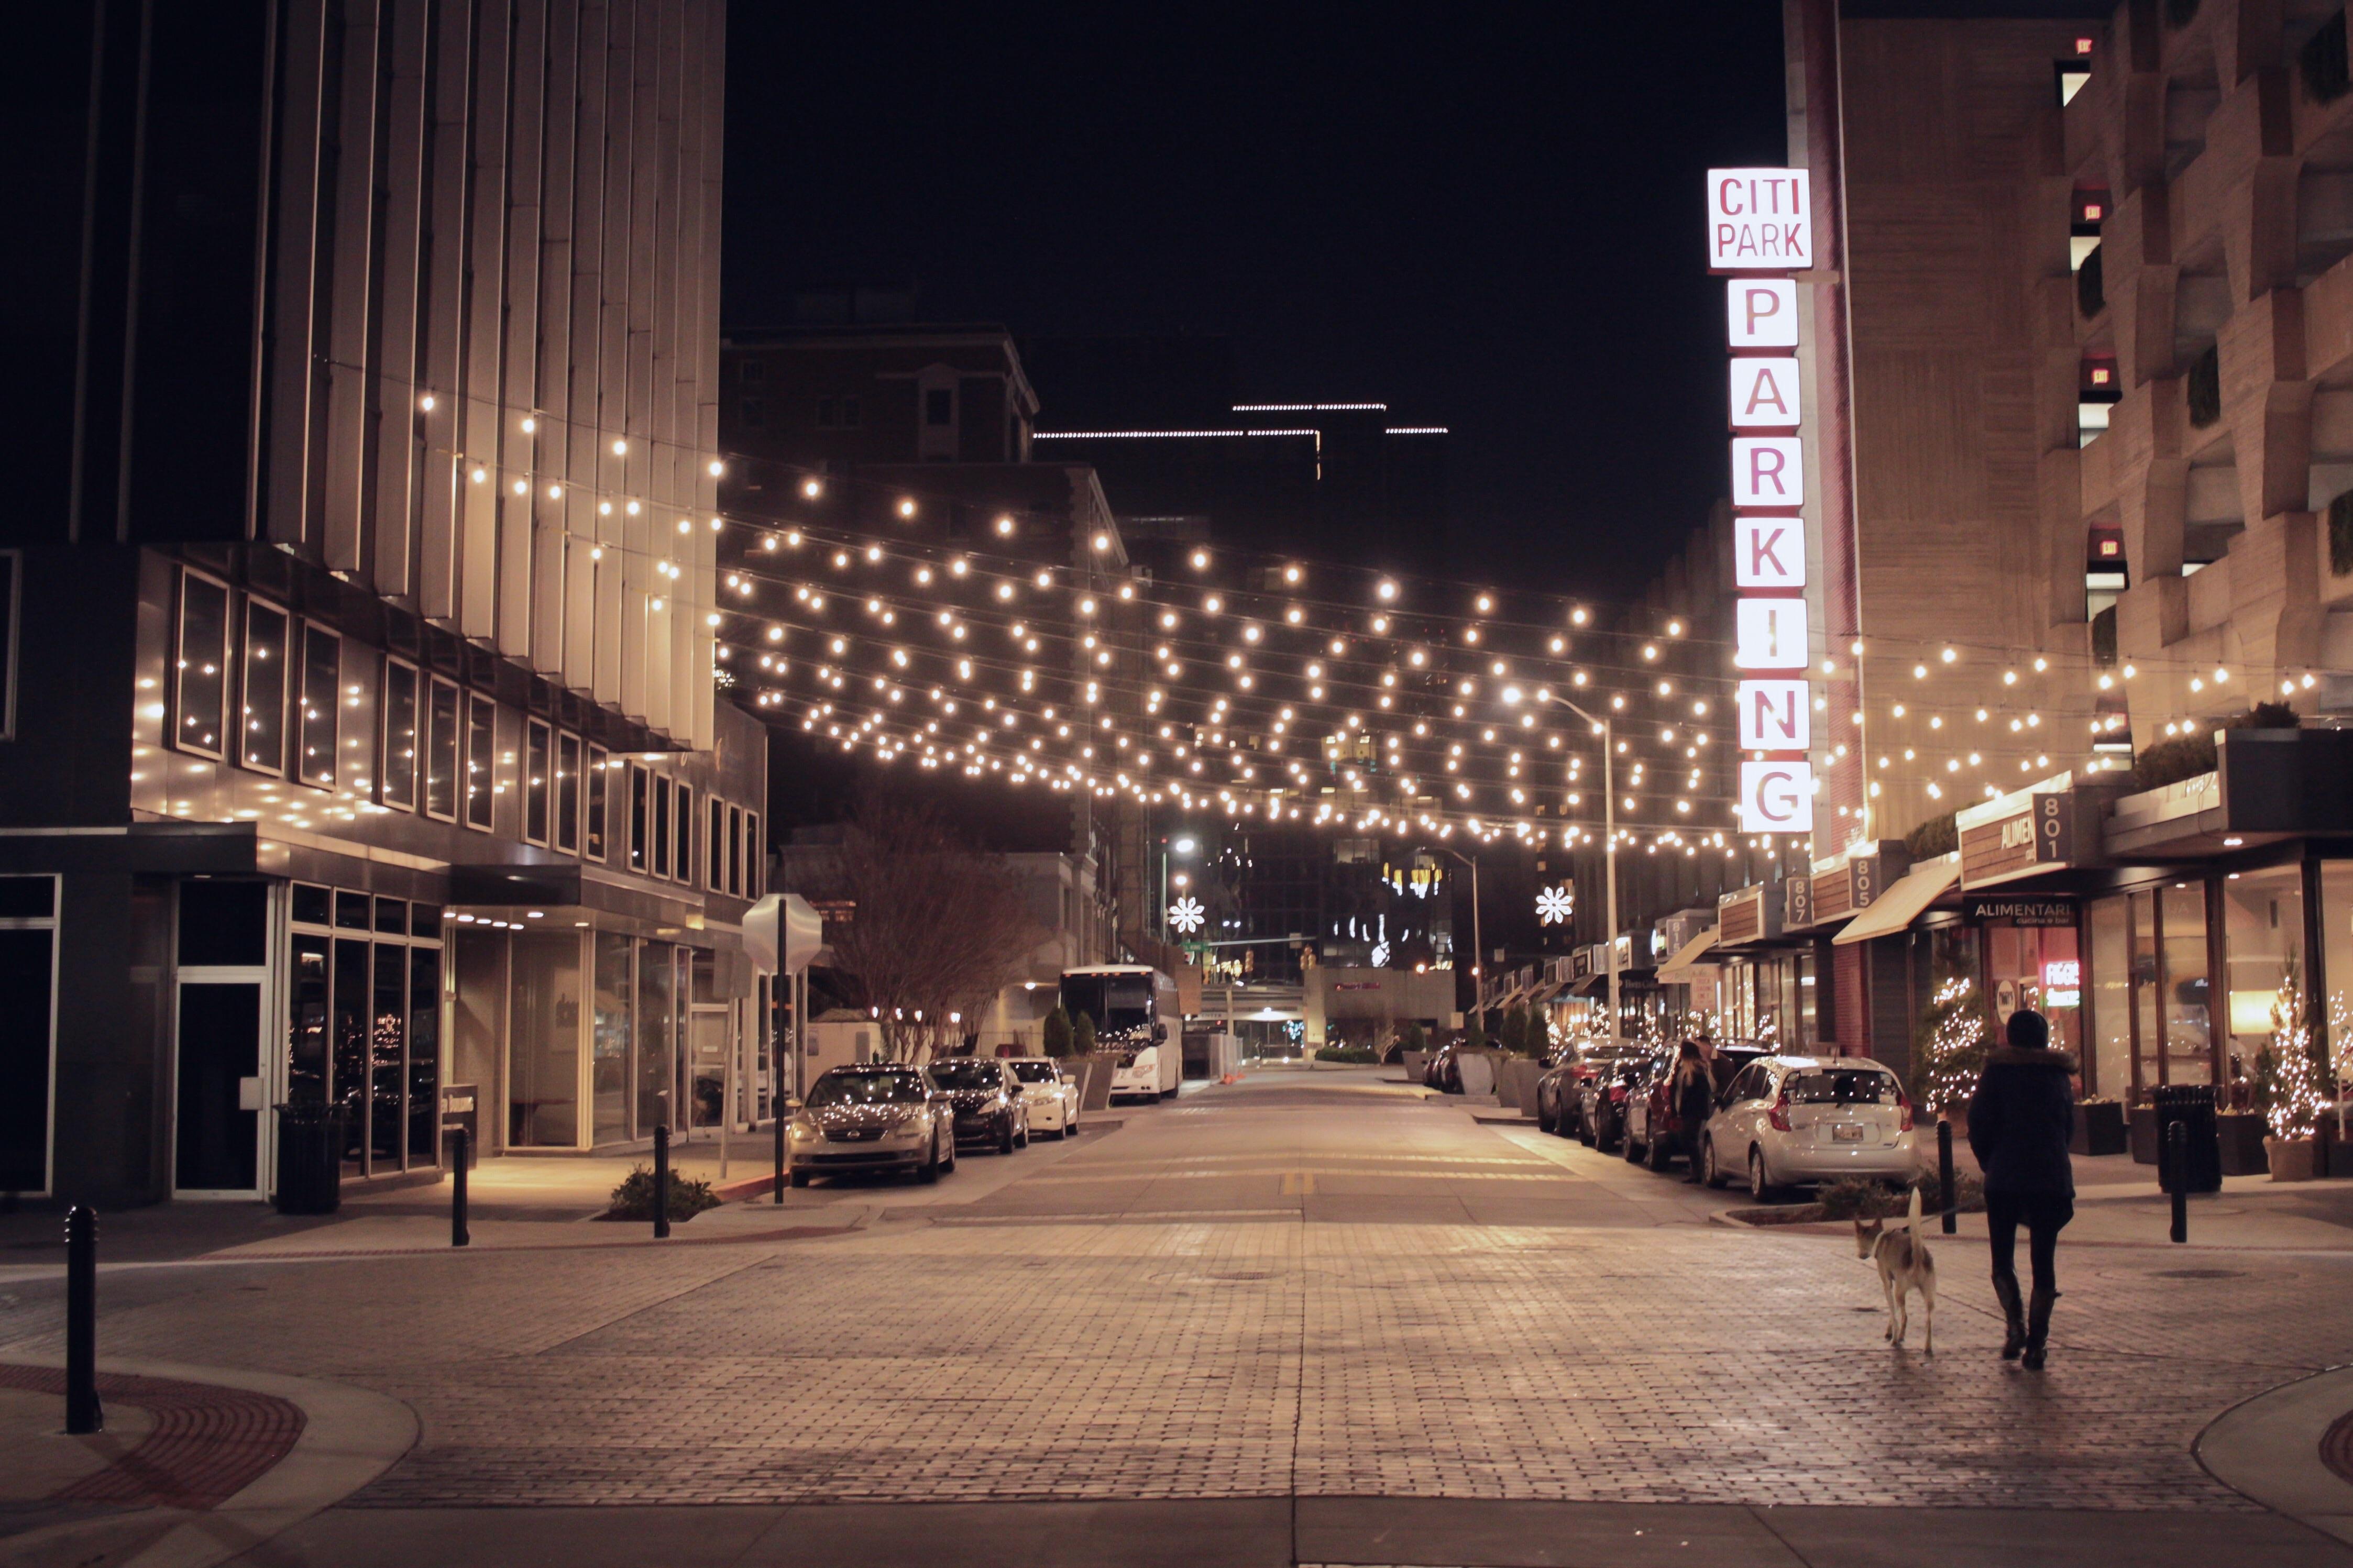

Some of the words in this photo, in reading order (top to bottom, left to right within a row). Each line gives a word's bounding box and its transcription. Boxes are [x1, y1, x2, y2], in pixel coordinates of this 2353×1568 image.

[1720, 178, 1800, 216] CITI
[1718, 223, 1804, 257] PARK
[1744, 289, 1799, 821] PARKING
[2044, 797, 2060, 858] 801
[1795, 880, 1806, 922] 807
[1857, 860, 1870, 907] 805
[1975, 904, 2070, 916] ALIMENTARI
